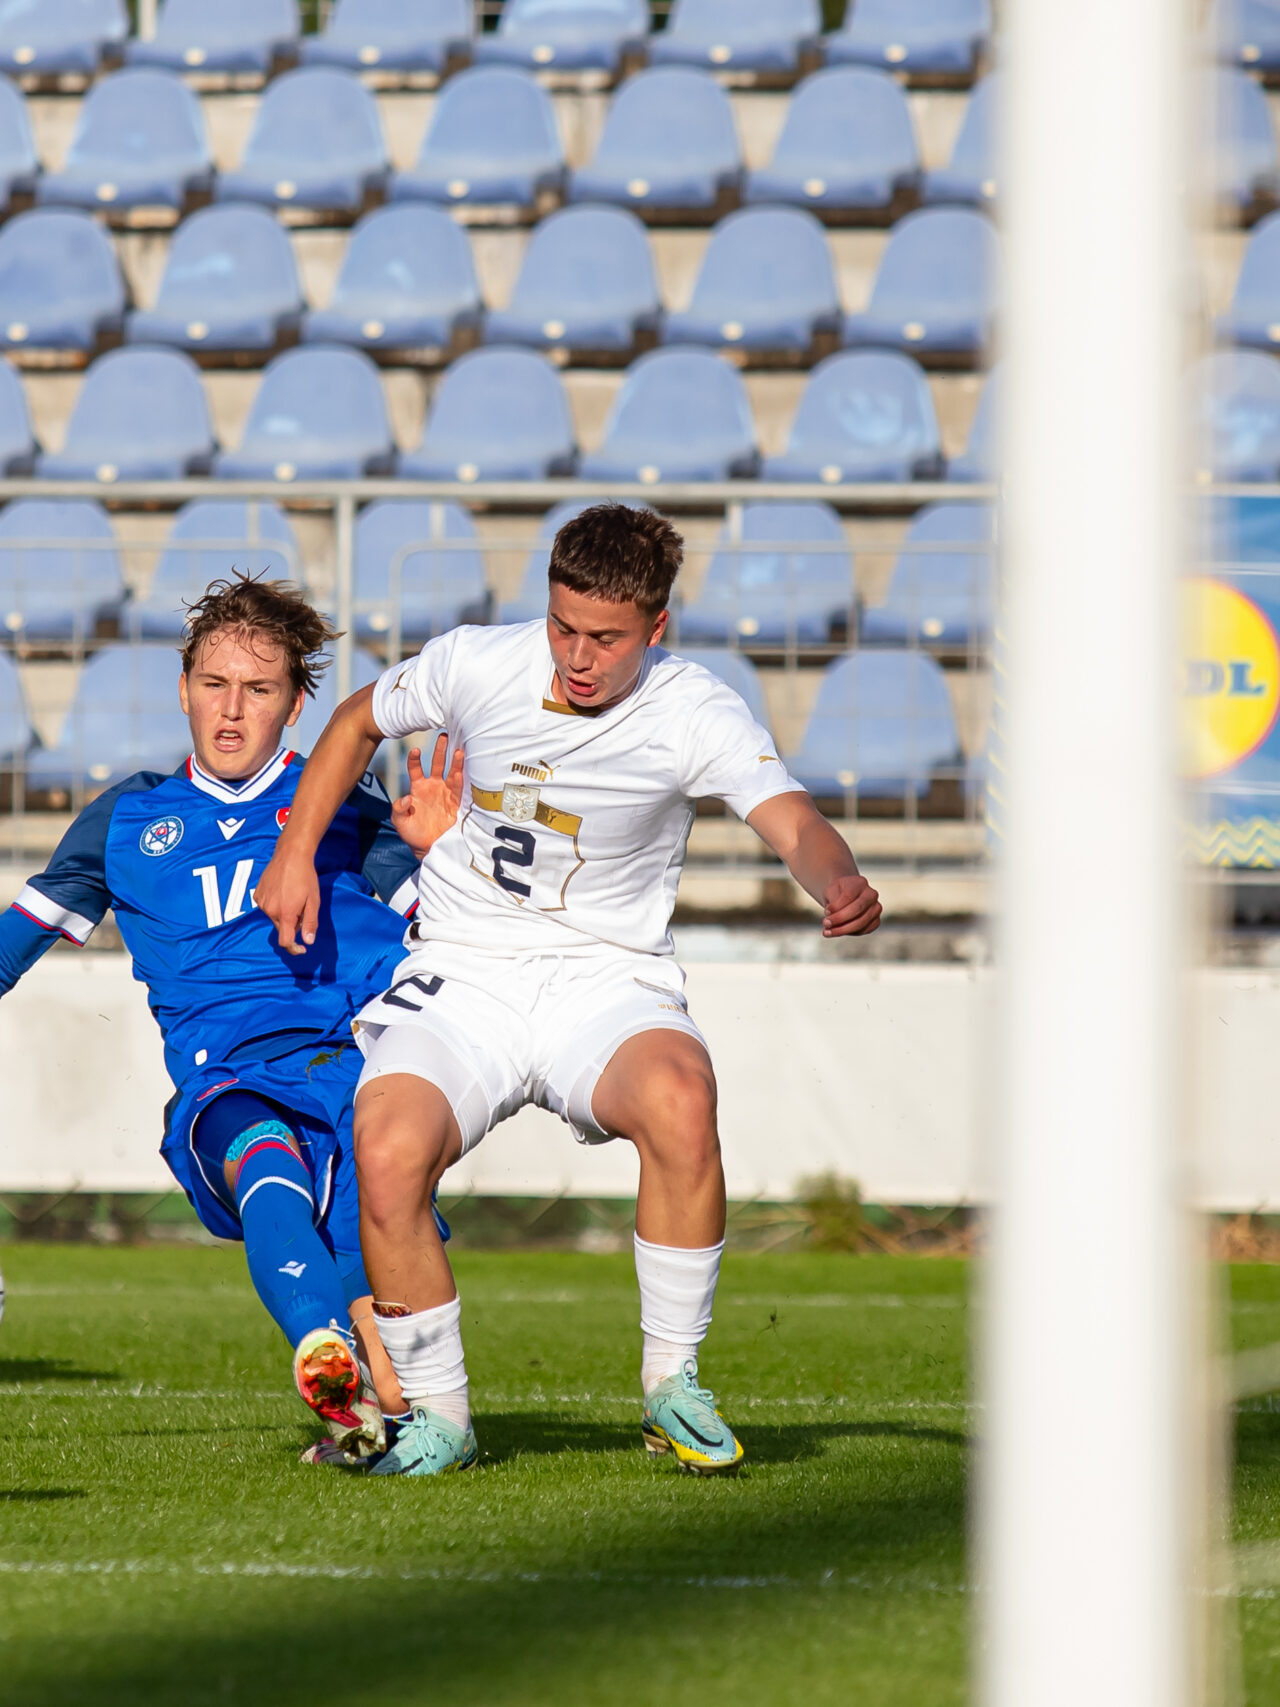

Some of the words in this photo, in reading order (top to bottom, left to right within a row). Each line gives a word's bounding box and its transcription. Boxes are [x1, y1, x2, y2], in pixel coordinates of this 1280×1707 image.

[1185, 660, 1266, 697] DL
[511, 762, 548, 783] PUMA
[491, 825, 537, 898] 2
